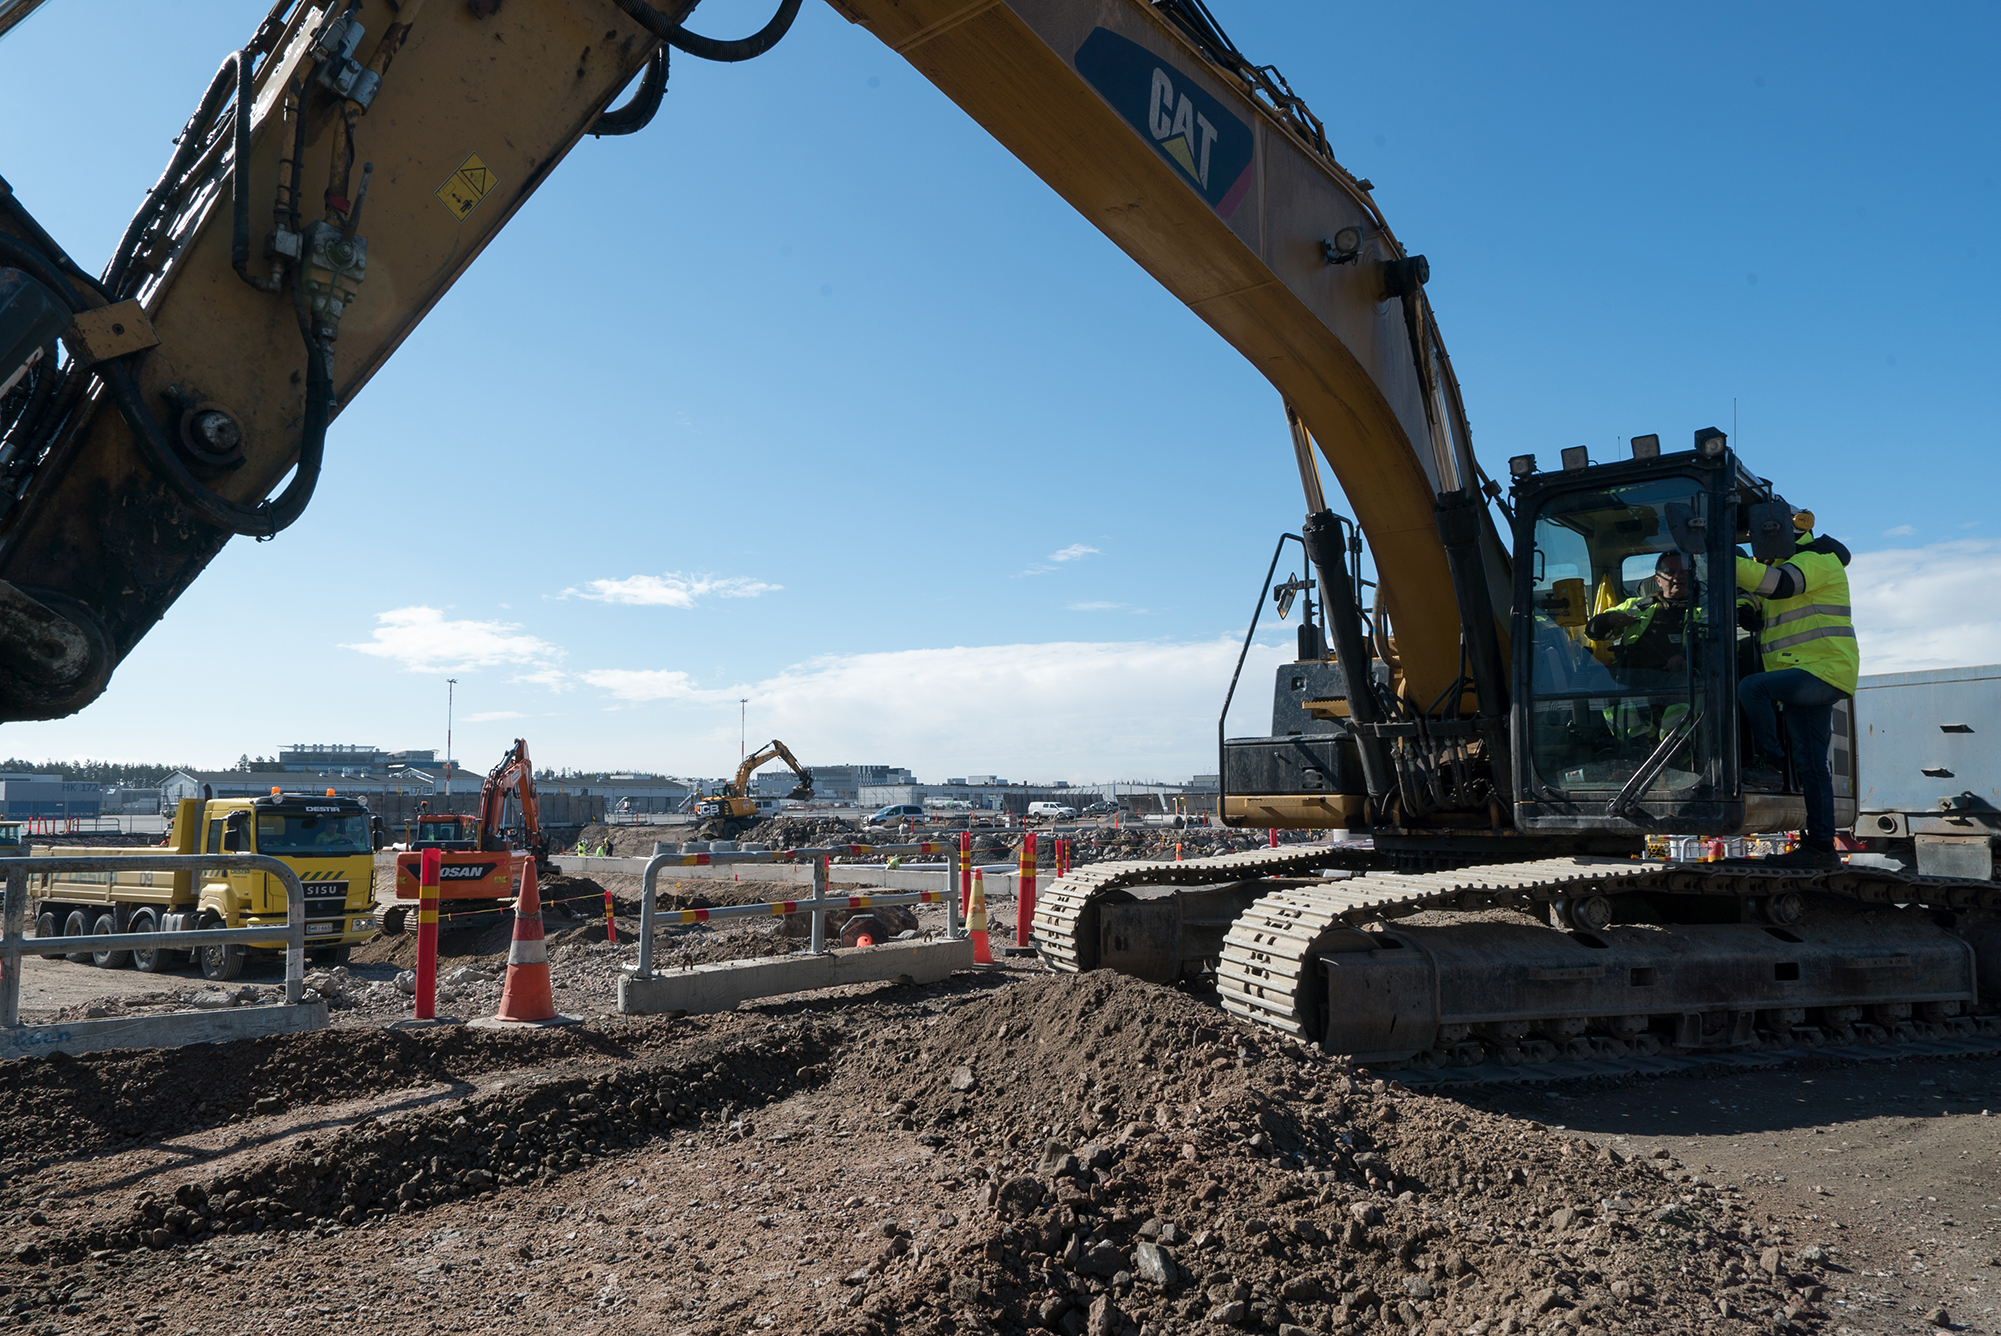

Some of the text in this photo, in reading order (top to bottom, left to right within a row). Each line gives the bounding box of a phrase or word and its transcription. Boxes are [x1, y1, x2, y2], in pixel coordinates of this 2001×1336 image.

[1148, 66, 1218, 191] CAT
[62, 783, 98, 792] HK 172
[697, 805, 720, 815] JCB
[307, 885, 337, 895] SISU
